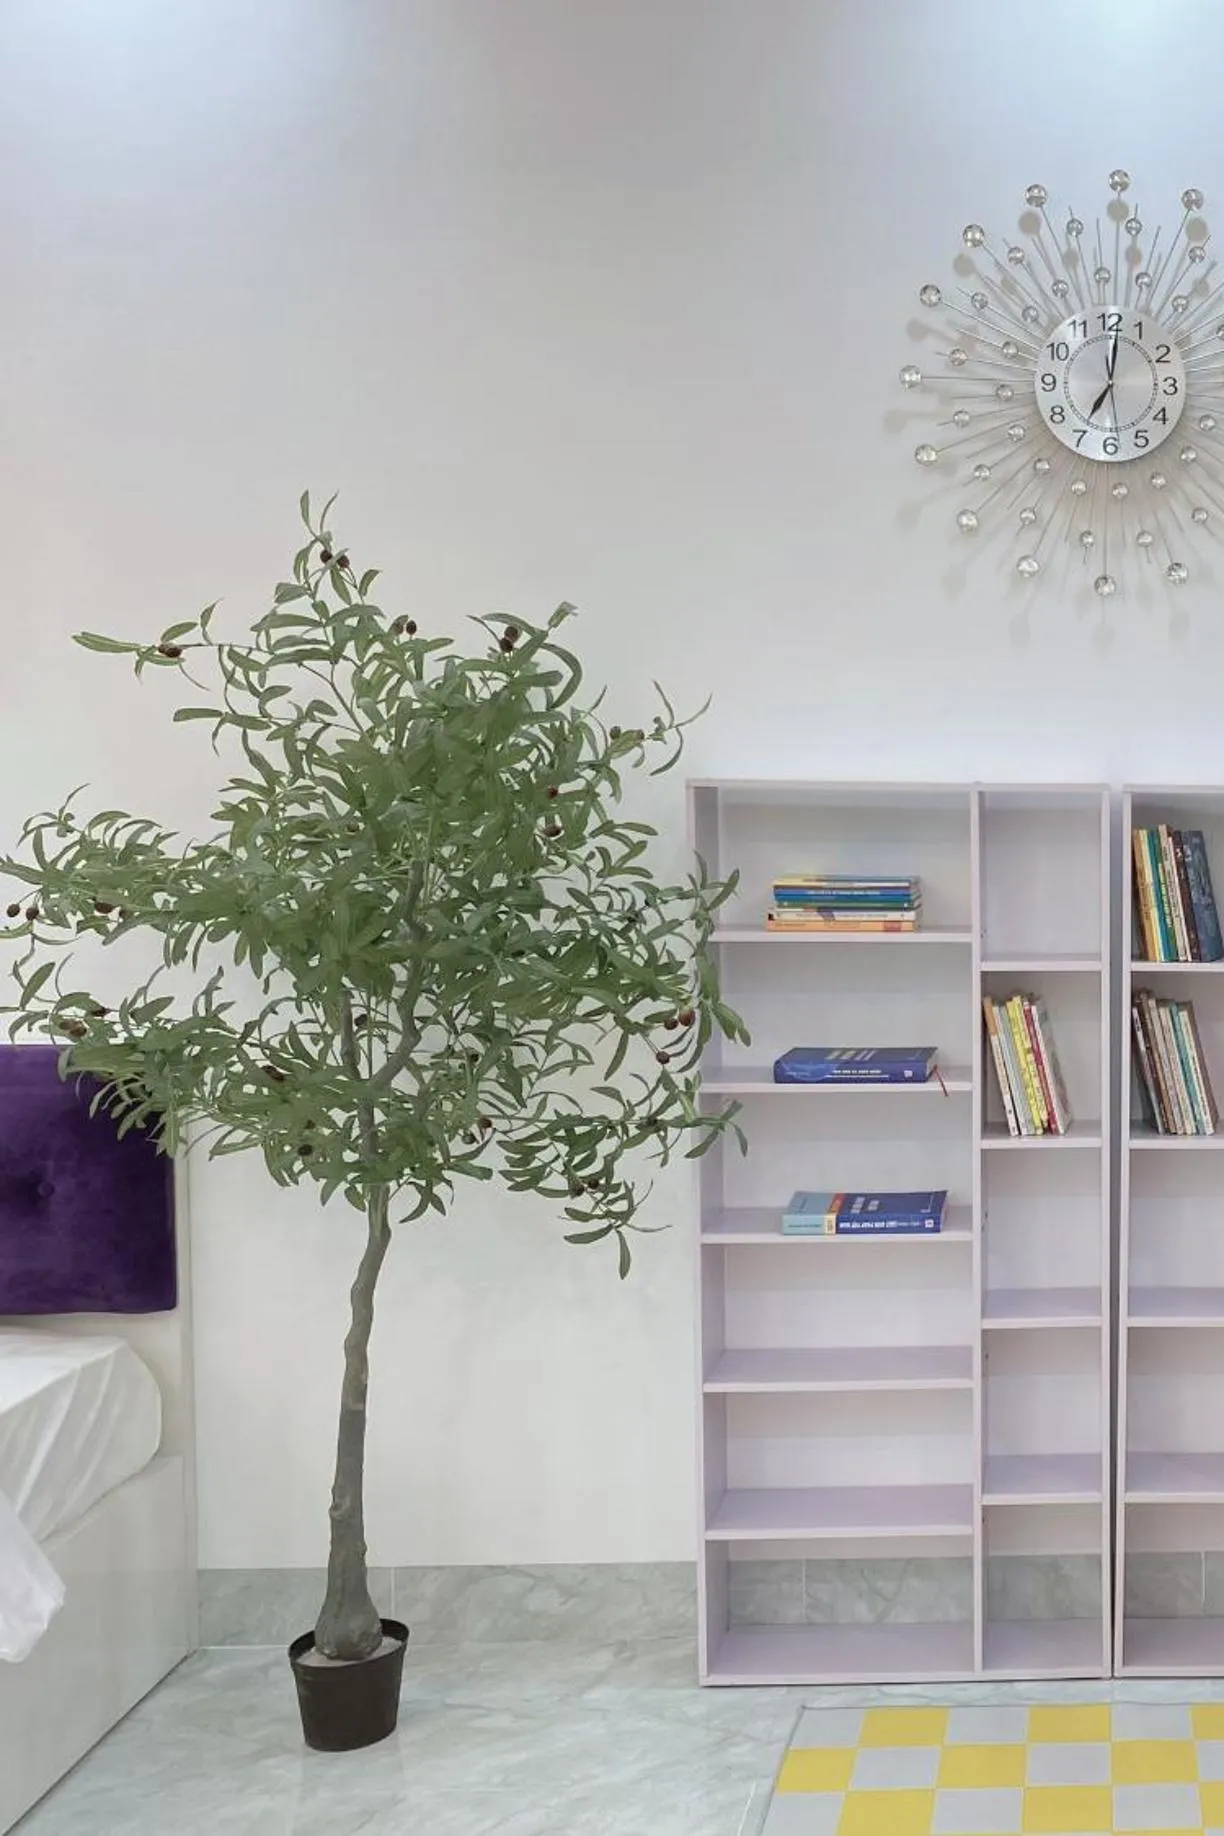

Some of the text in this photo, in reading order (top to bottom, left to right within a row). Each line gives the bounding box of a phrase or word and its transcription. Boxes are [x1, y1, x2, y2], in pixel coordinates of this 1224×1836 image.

[1068, 320, 1087, 338] 11
[1097, 313, 1123, 332] 12
[1133, 321, 1143, 340] 1
[1047, 342, 1069, 361] 10
[1155, 344, 1171, 363] 2
[1041, 373, 1056, 392] 9
[1162, 376, 1178, 396] 3
[1050, 405, 1065, 424] 8
[1152, 407, 1169, 425] 4
[1072, 429, 1088, 448] 7
[1103, 437, 1119, 456] 6
[1134, 430, 1149, 448] 5
